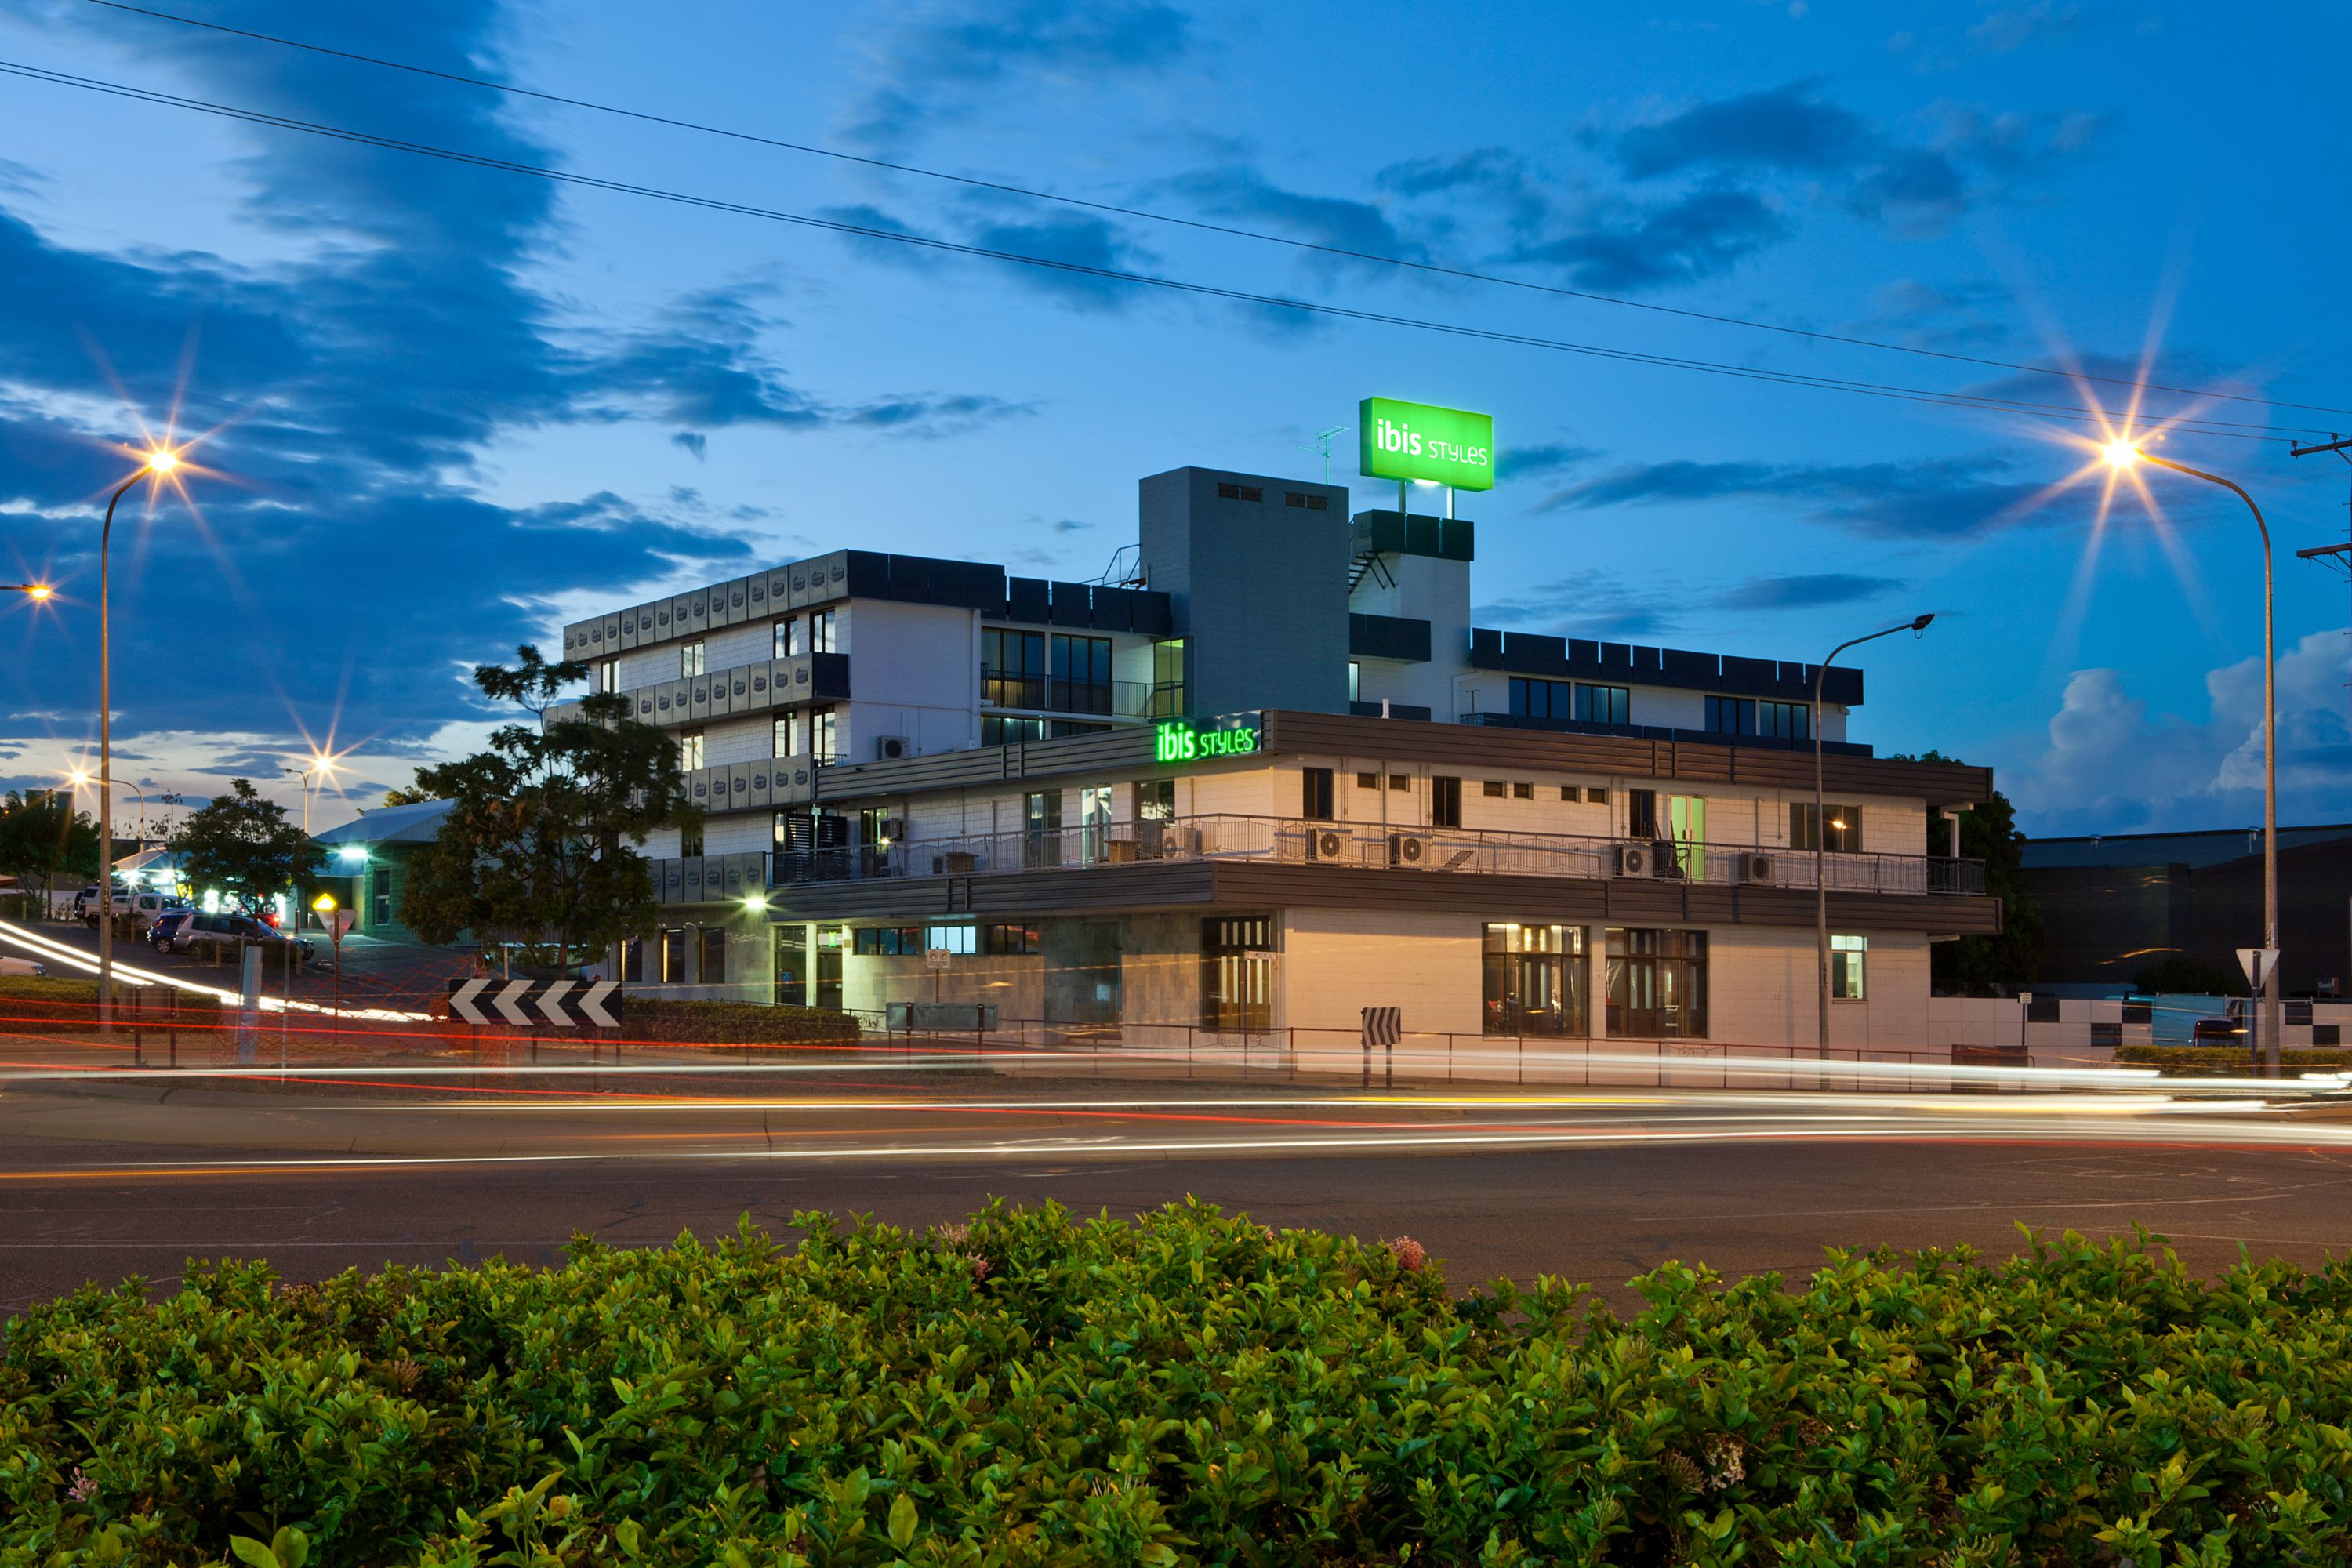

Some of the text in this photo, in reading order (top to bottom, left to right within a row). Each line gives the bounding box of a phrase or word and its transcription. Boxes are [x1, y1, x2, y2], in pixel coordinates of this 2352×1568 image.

[1377, 419, 1488, 466] ibis STYLES
[1158, 722, 1253, 762] ibis STYLES
